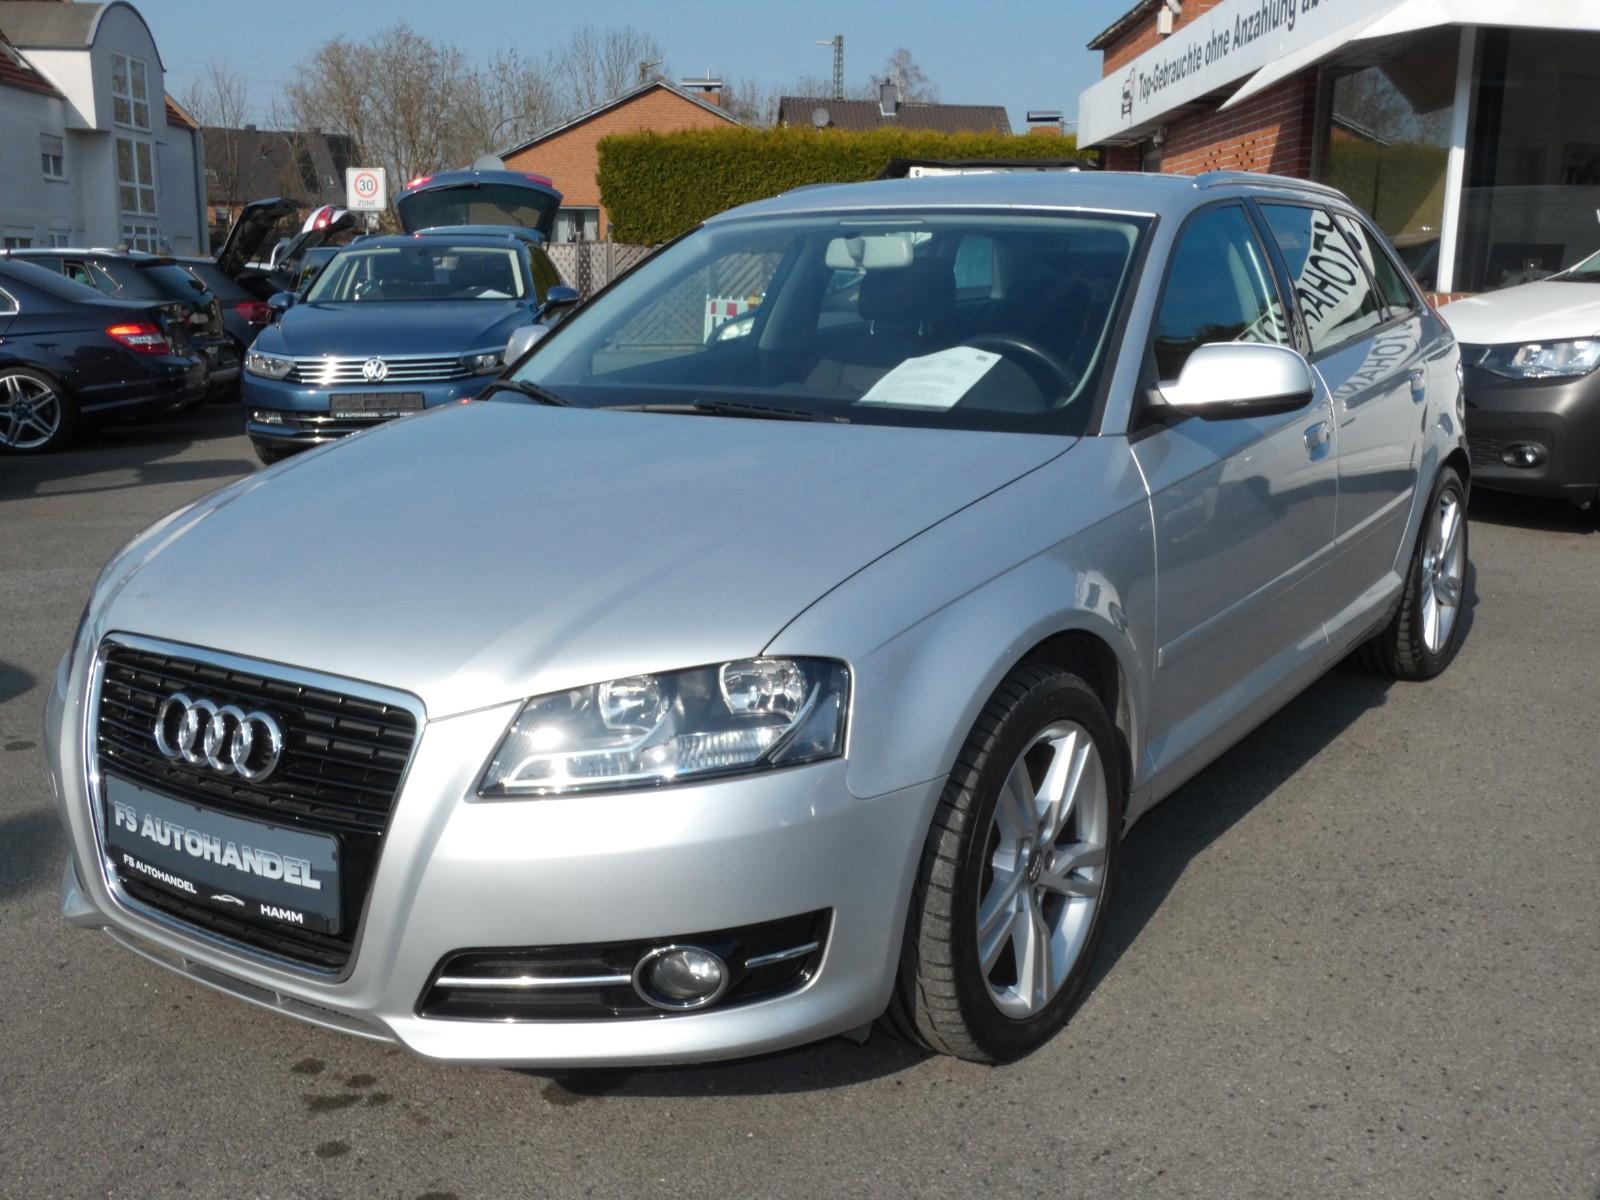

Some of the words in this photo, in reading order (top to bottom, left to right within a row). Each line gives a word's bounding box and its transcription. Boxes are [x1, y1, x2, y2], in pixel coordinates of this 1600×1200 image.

[1138, 43, 1203, 103] Top-Gebrauchte
[1204, 29, 1230, 68] ohne
[1232, 0, 1297, 51] Anzahlung
[359, 179, 373, 191] 30
[115, 802, 137, 833] FS
[141, 814, 321, 890] AUTOHANDEL
[123, 853, 136, 868] FS
[135, 858, 198, 894] AUTOHANDEL
[260, 903, 304, 925] HAMM
